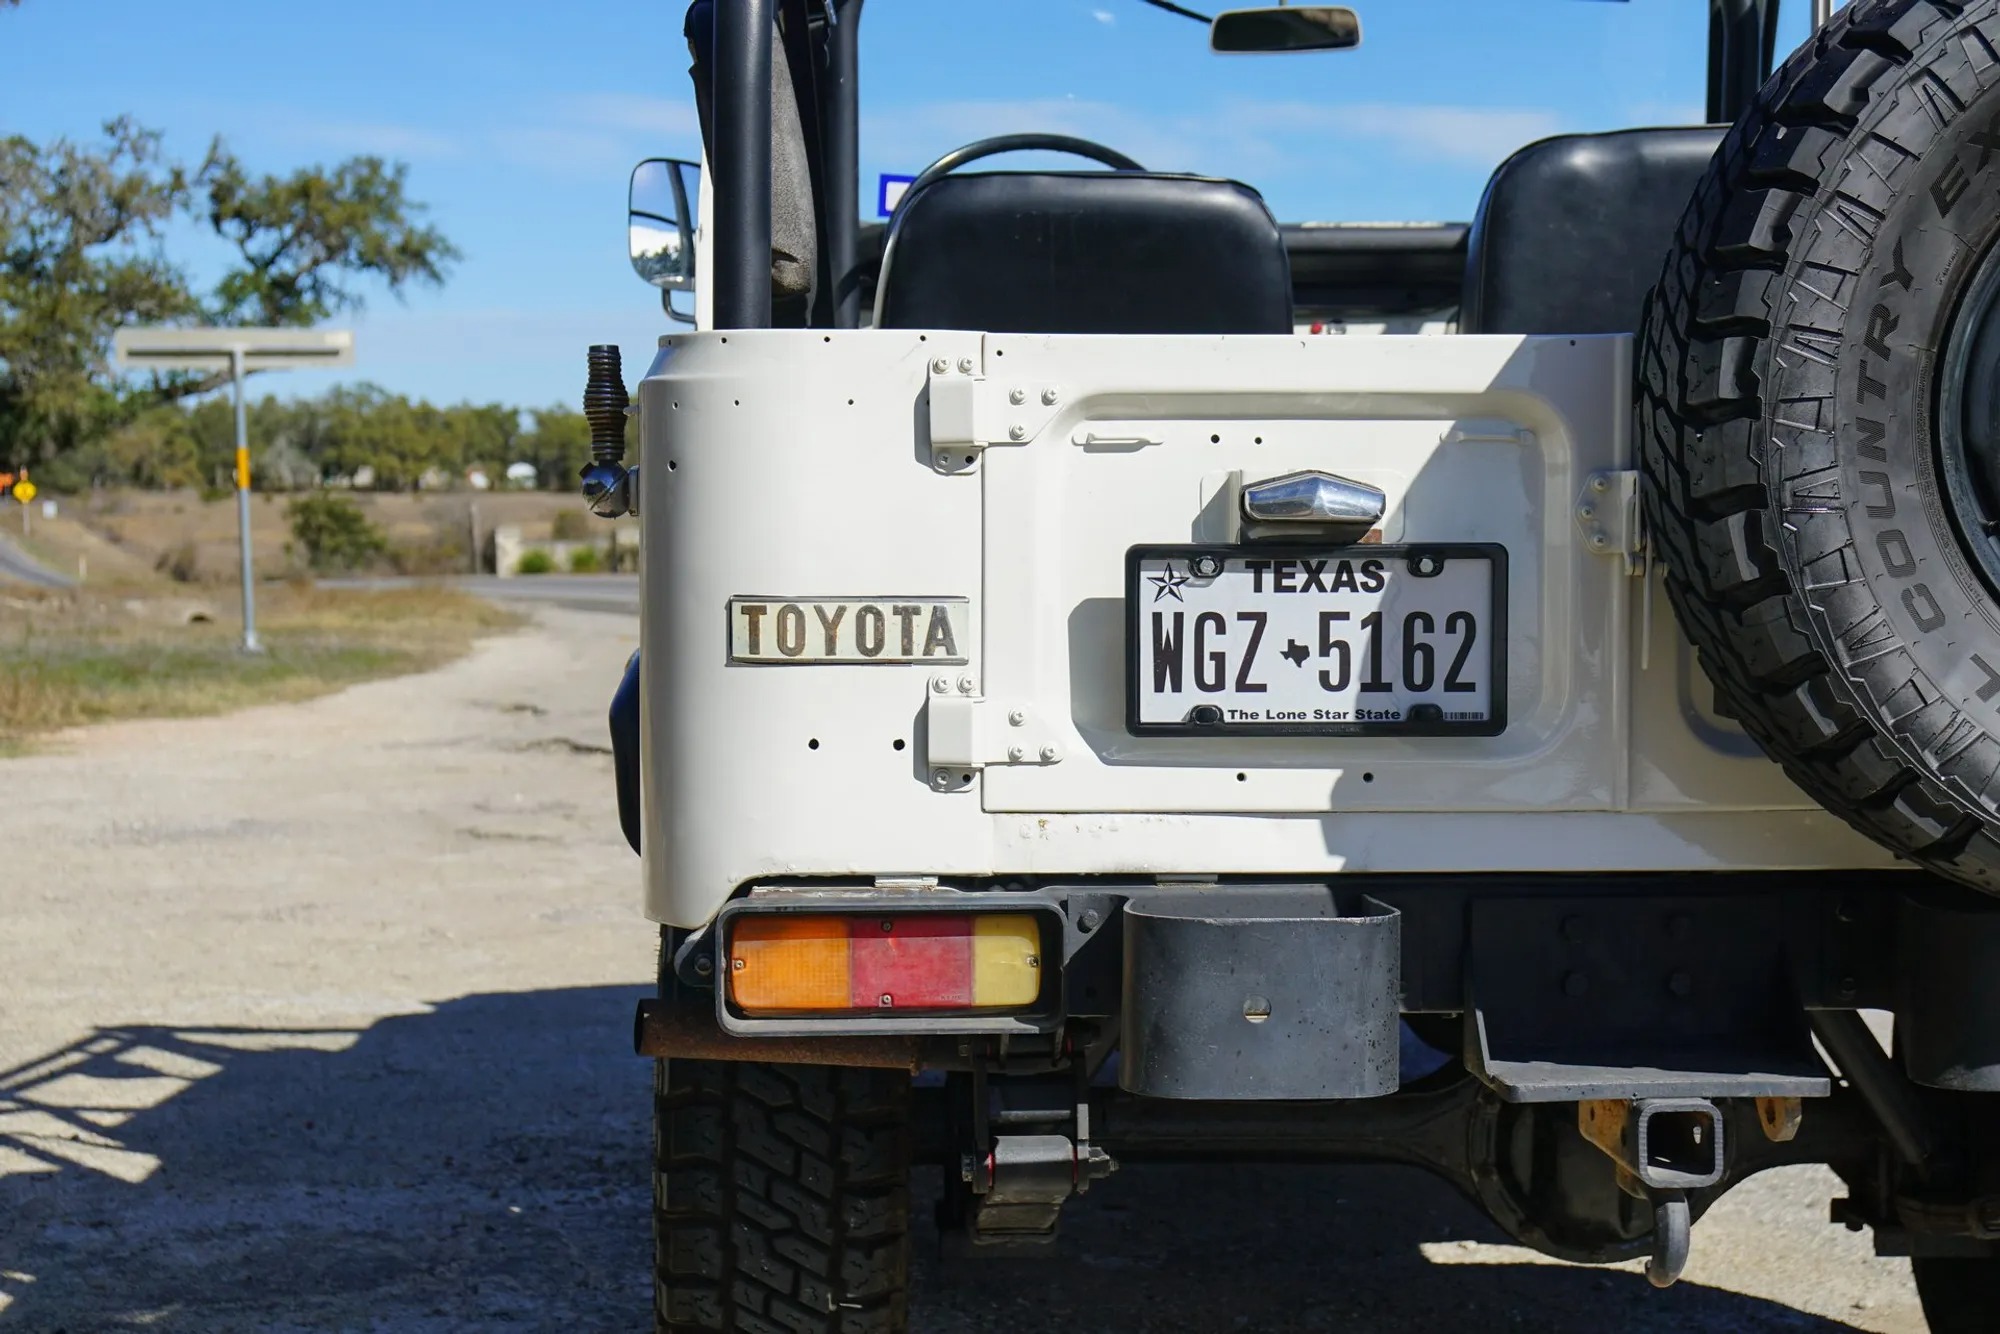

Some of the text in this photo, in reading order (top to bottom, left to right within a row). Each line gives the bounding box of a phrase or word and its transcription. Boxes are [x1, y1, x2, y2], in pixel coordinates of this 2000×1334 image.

[1855, 236, 1946, 633] COUNTRY
[1245, 560, 1385, 593] TEXAS
[741, 603, 958, 657] TOYOTA
[1152, 611, 1477, 693] WGZ 5162
[1228, 709, 1401, 720] The Lone Star State
